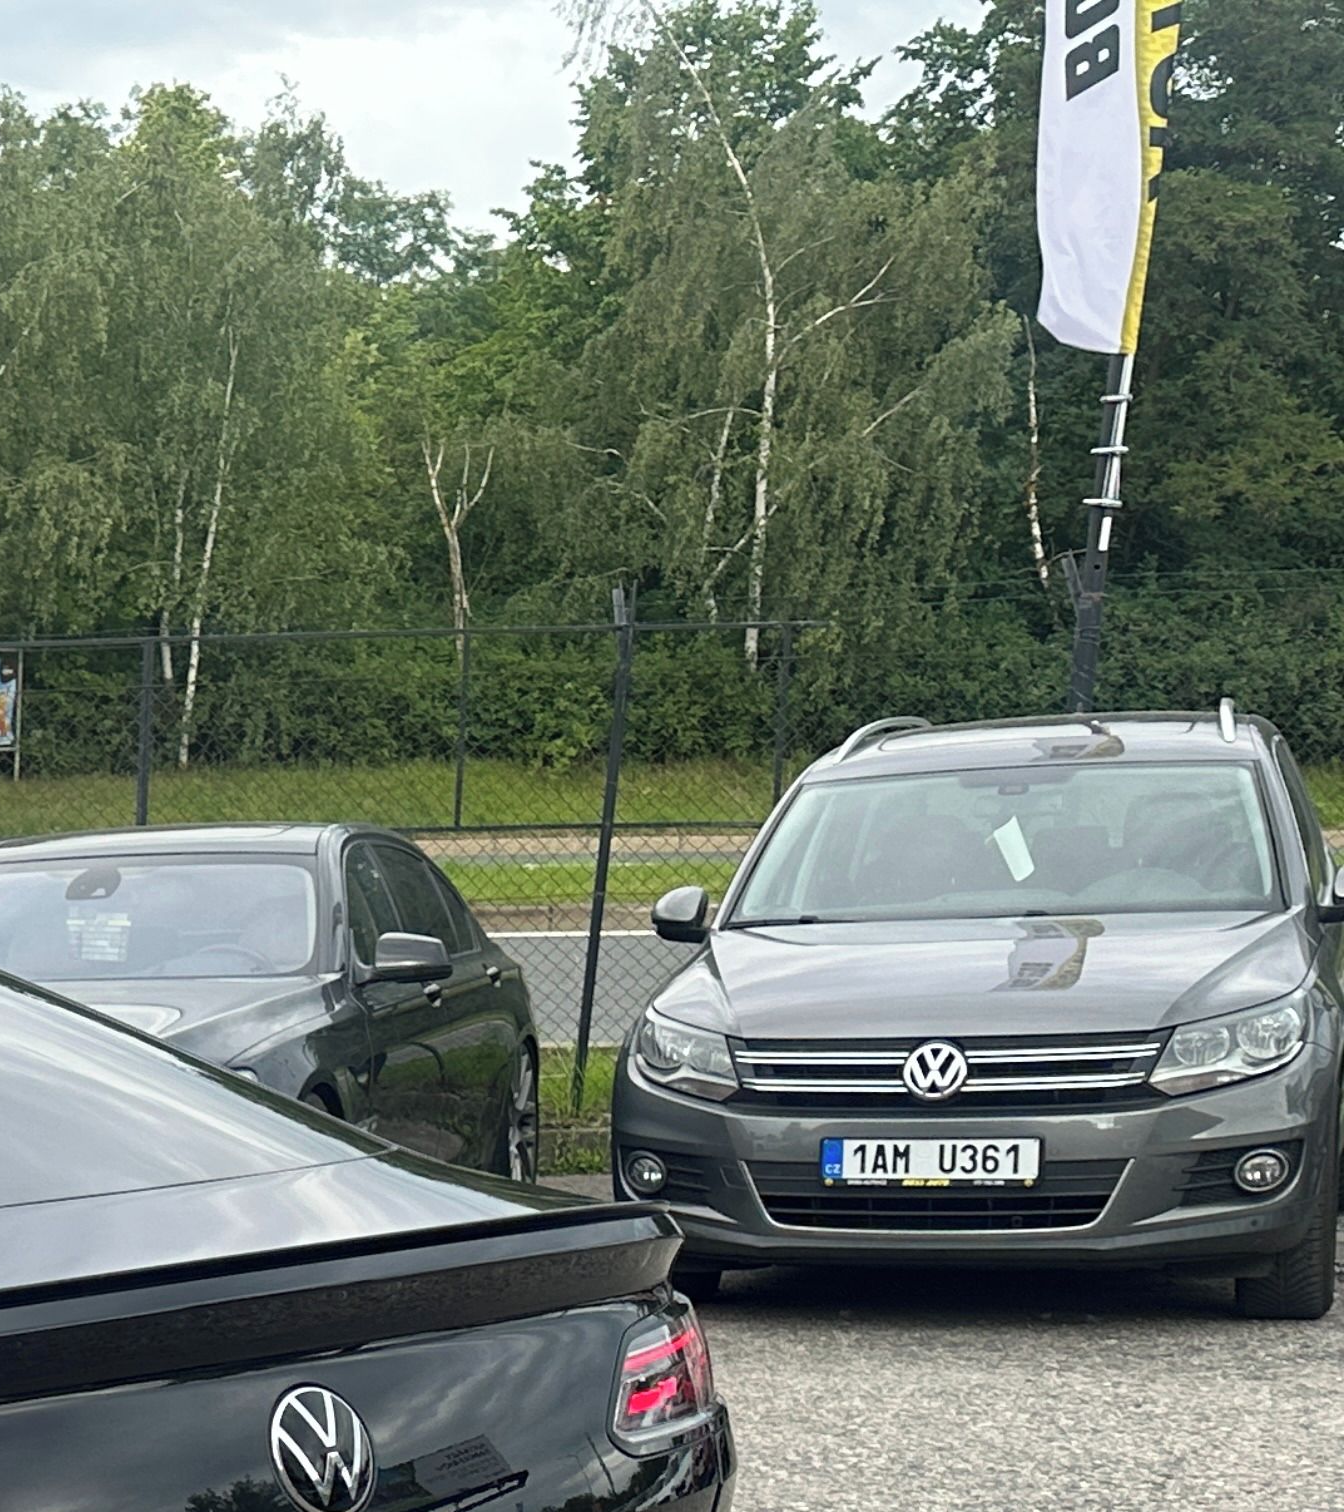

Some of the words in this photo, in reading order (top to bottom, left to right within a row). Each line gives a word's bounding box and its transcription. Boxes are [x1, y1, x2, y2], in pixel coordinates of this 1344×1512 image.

[824, 1163, 842, 1174] CZ
[853, 1144, 911, 1174] 1AM
[938, 1144, 1021, 1174] U361
